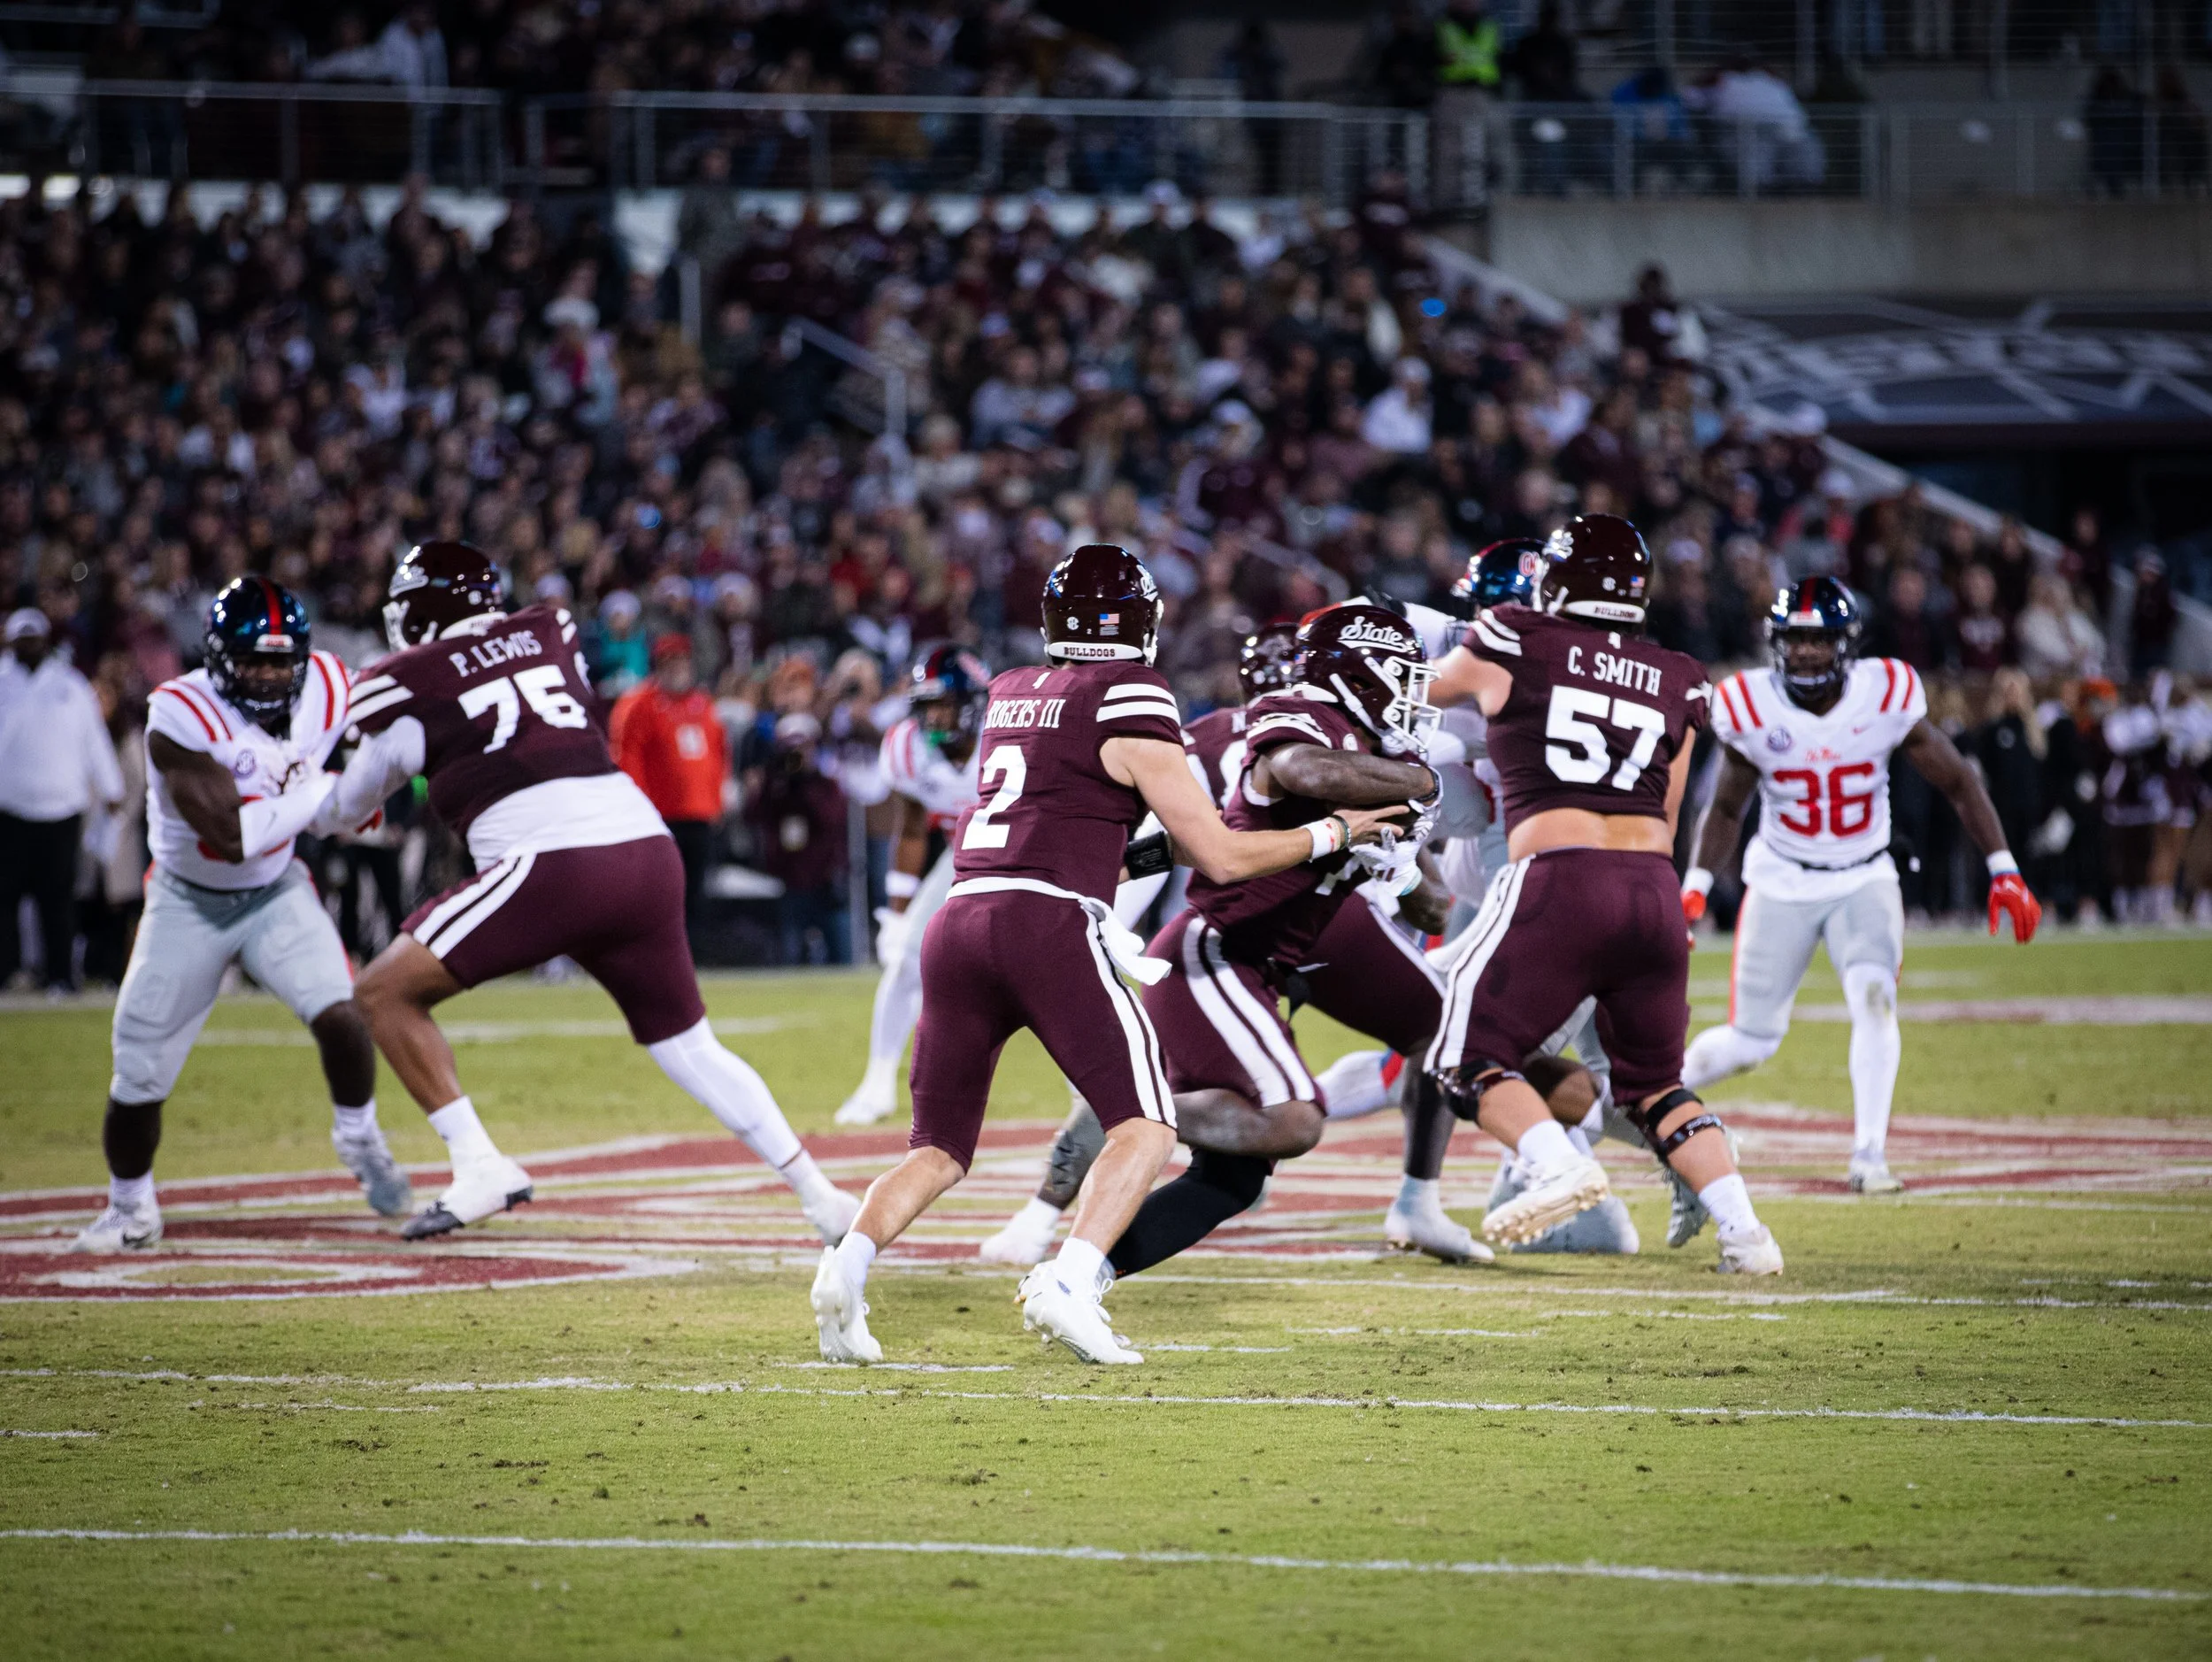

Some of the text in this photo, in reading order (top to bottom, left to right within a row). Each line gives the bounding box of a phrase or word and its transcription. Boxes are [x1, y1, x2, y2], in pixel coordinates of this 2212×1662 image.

[1064, 646, 1116, 657] BULLDOGS
[1337, 616, 1405, 650] State
[1593, 651, 1663, 696] SMITH
[1037, 698, 1066, 728] III
[1546, 685, 1665, 791] 57
[962, 745, 1026, 850] 2
[1773, 761, 1874, 838] 36
